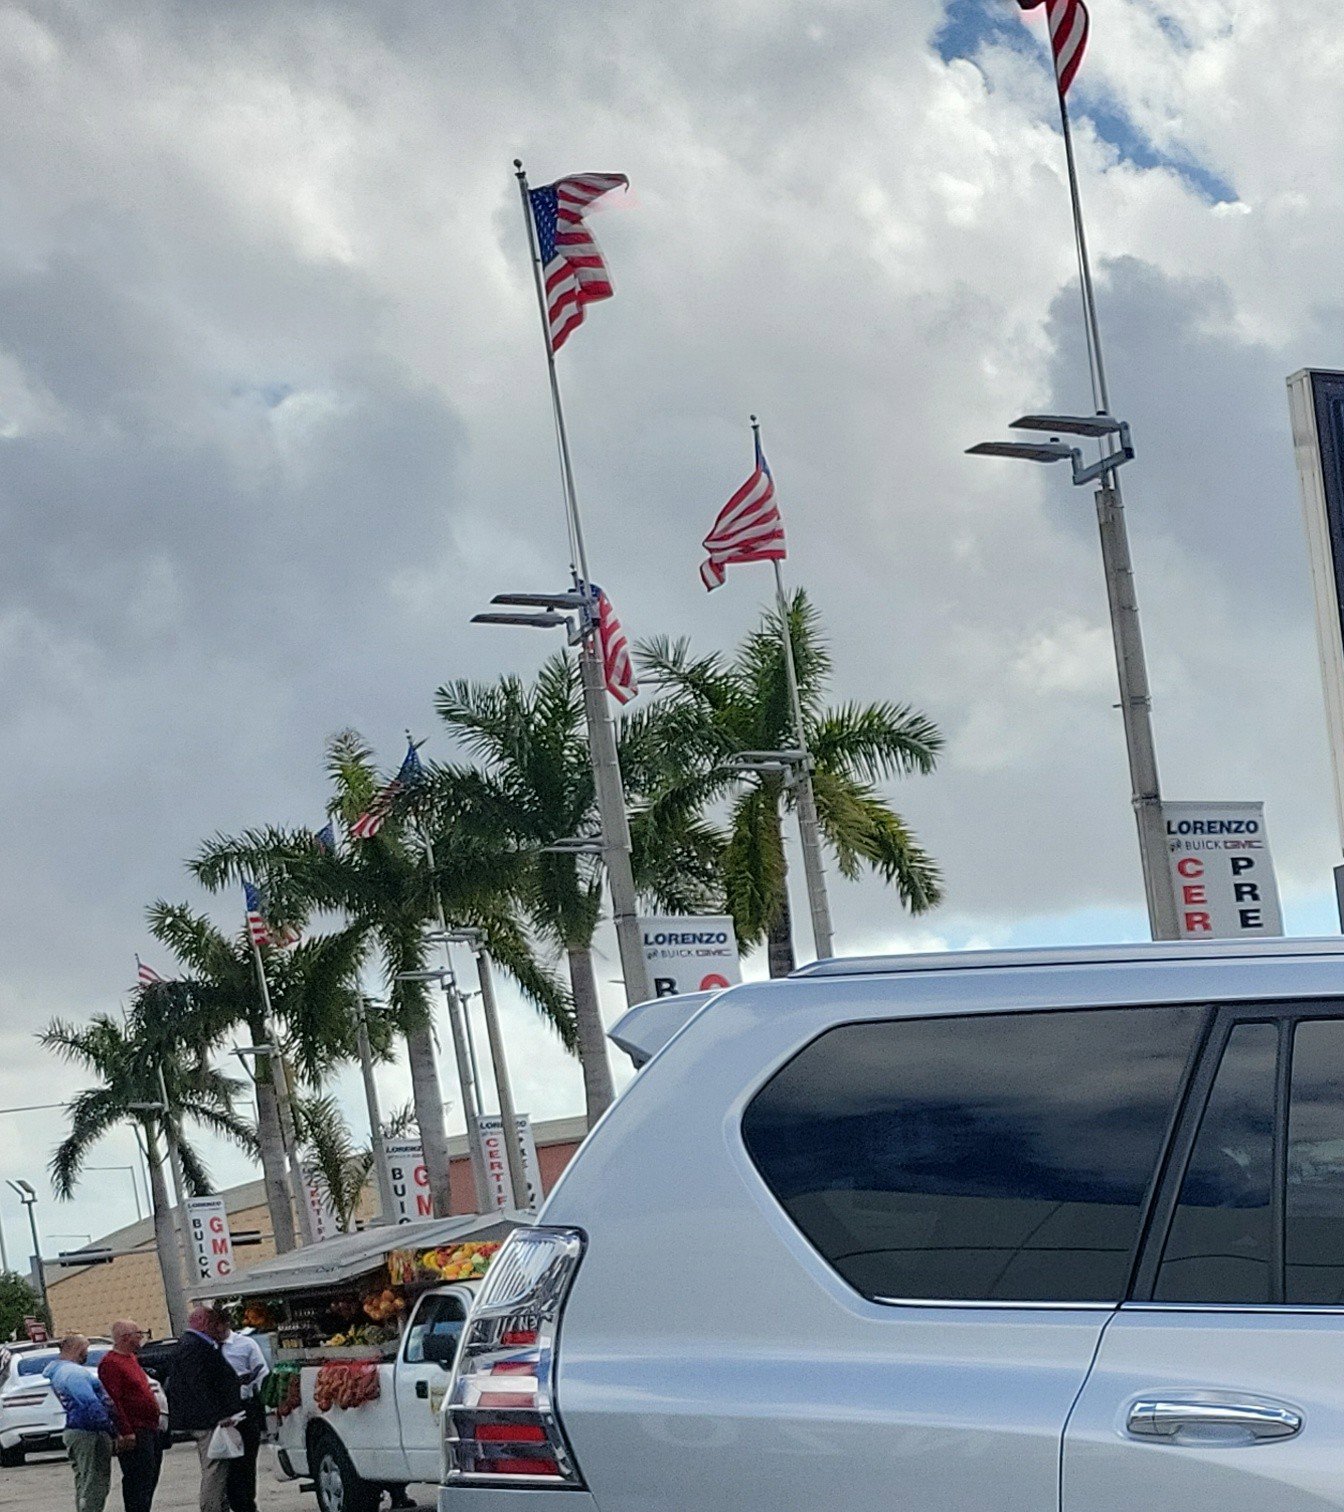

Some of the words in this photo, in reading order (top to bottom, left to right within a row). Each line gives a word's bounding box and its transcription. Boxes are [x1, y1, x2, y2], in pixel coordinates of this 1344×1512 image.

[1166, 820, 1259, 835] LORENZO
[1185, 840, 1223, 850] BUICK
[1177, 857, 1212, 932] CER
[1230, 857, 1263, 929] PRE
[644, 932, 728, 945] LORENZO
[192, 1218, 211, 1279] BUICK
[209, 1216, 231, 1276] GMC
